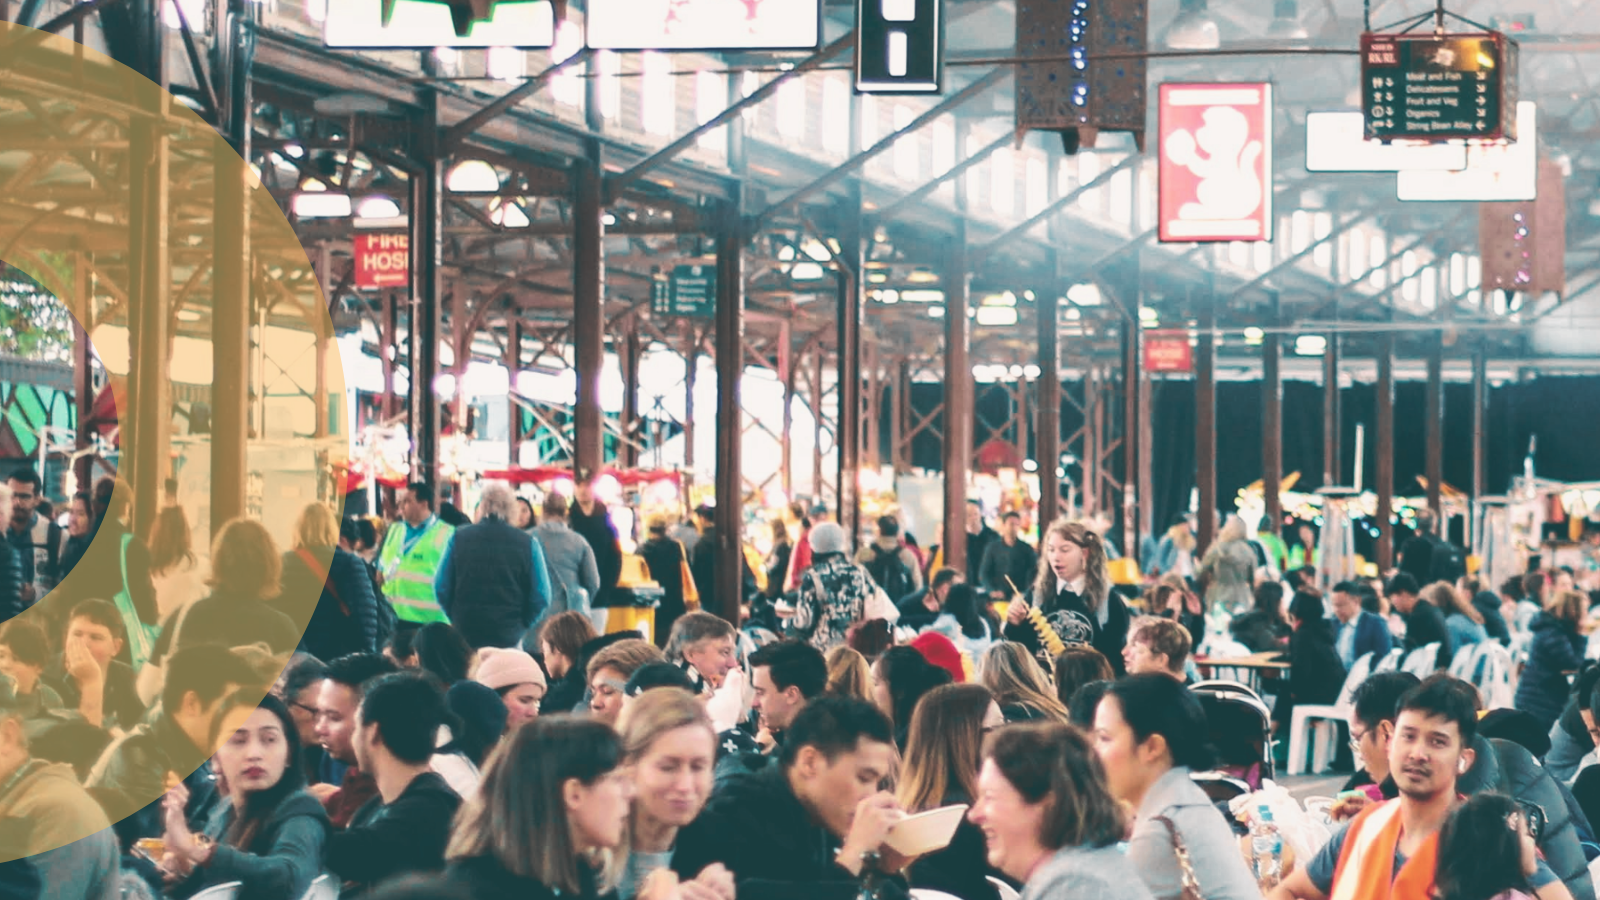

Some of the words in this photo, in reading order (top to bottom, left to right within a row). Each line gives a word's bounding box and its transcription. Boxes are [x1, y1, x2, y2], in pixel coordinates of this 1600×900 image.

[1406, 72, 1426, 81] Meat
[1427, 72, 1443, 81] and
[1445, 72, 1462, 81] Fish
[1406, 84, 1459, 94] Delicatessens
[1406, 97, 1424, 106] Fruit
[1426, 97, 1441, 106] and
[1442, 97, 1459, 107] Veg
[1406, 109, 1440, 119] Organics
[1406, 121, 1430, 132] String
[1431, 121, 1452, 131] Bean
[1453, 121, 1473, 131] Alley
